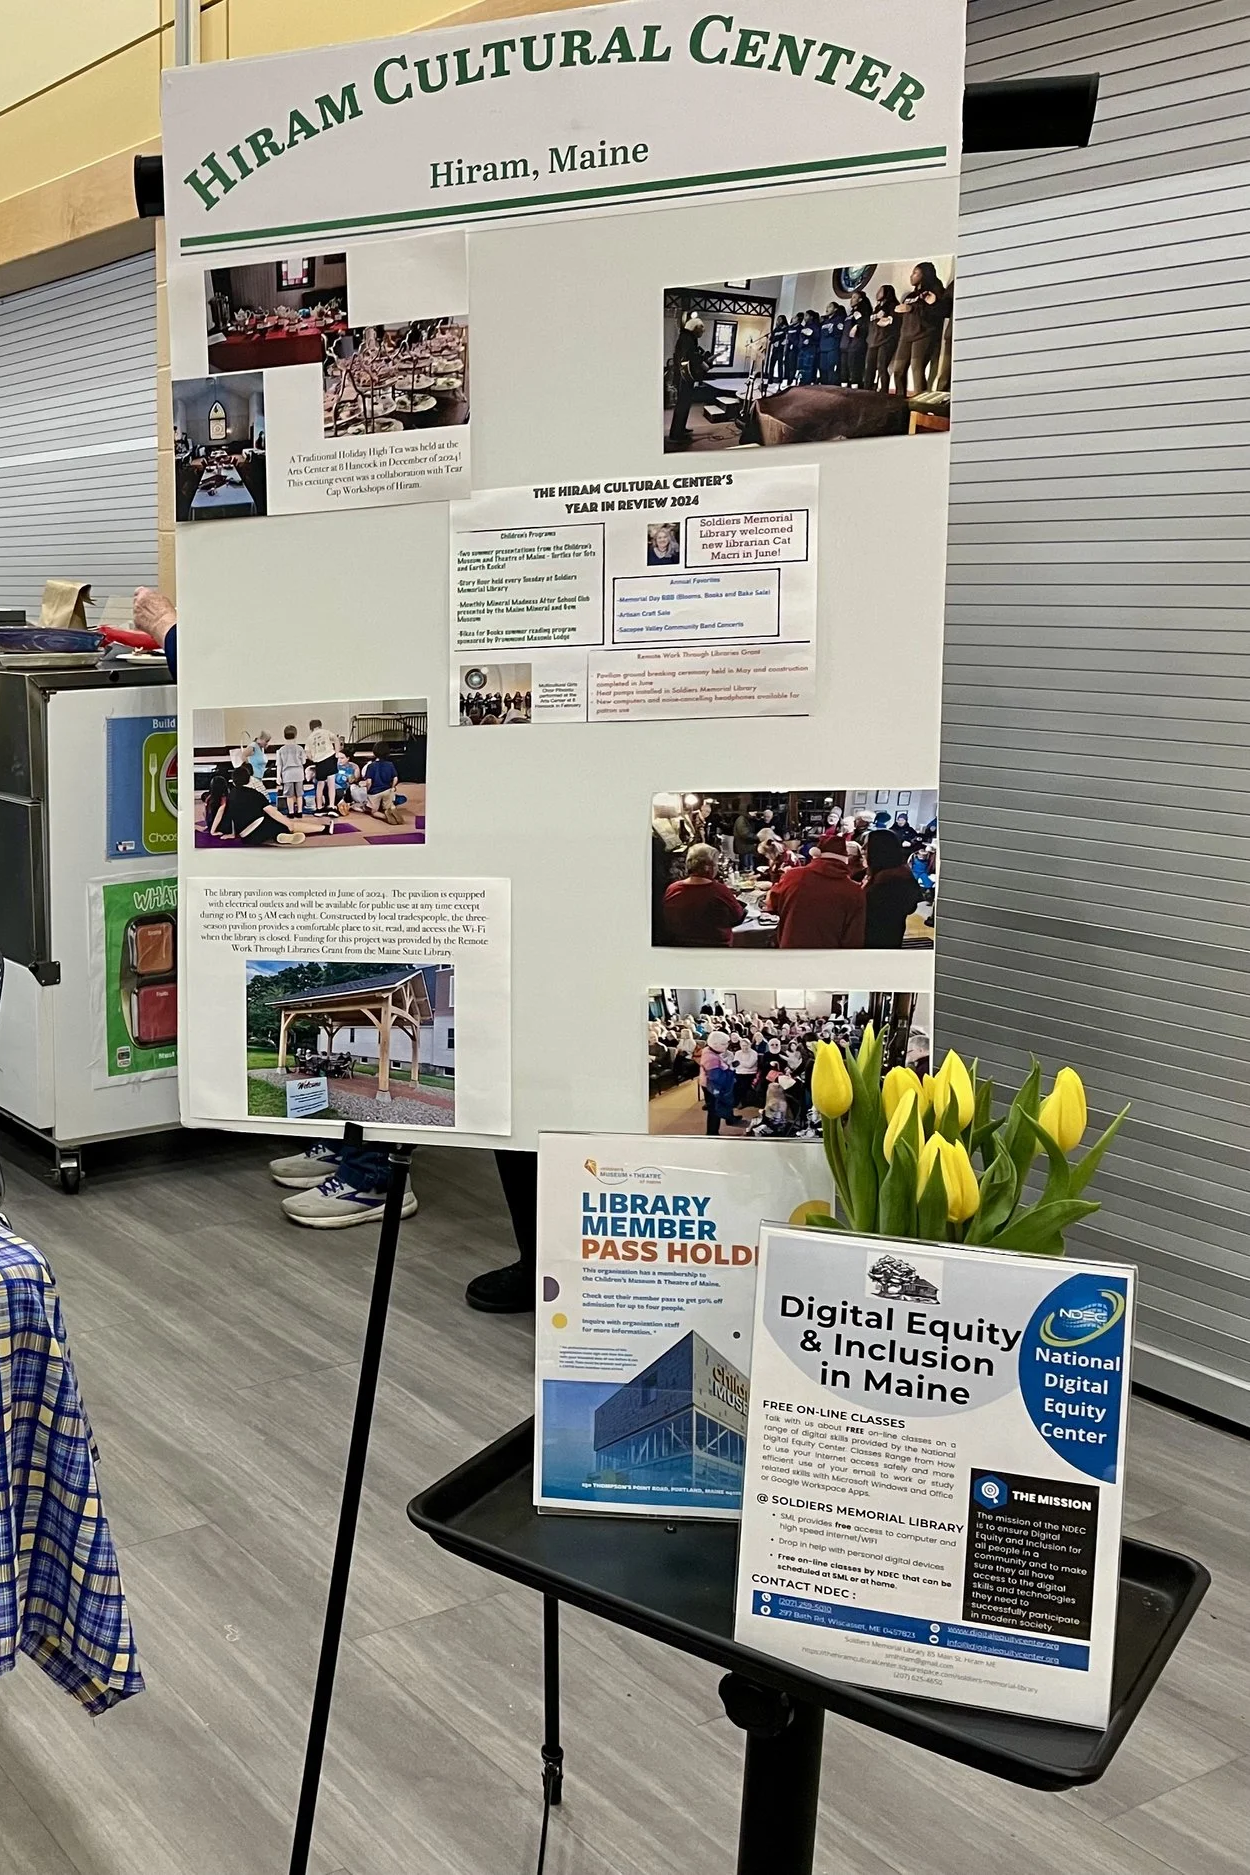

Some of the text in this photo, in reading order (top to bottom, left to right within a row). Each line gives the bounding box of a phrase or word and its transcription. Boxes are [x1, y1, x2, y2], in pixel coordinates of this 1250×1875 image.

[183, 15, 927, 212] HIRAM CULTURAL CENTER
[430, 139, 648, 191] Hiram, Maine
[297, 452, 337, 462] Traditional
[339, 449, 367, 459] Holiday
[369, 448, 387, 457] High
[389, 446, 403, 454] Tea
[420, 442, 436, 451] held
[326, 488, 341, 497] Cap
[343, 484, 385, 495] Workshops
[396, 481, 421, 490] Hiram.
[533, 474, 733, 498] THE HIRAM CULTURAL CENTER'S
[565, 495, 699, 514] YEAR IN REVIEW 2024
[700, 514, 793, 527] Soldiers Memorial
[700, 525, 793, 539] Library welcomed
[702, 537, 791, 549] new librarian Cat
[711, 551, 740, 560] Macri
[755, 549, 781, 558] June!
[152, 719, 175, 729] Build
[134, 885, 177, 911] WHAT
[219, 889, 242, 898] library
[244, 889, 272, 898] pavilion
[289, 890, 326, 899] completed
[337, 890, 354, 898] June
[356, 889, 365, 897] of
[408, 890, 438, 899] pavilion
[448, 891, 485, 900] equipped
[232, 944, 252, 952] Work
[254, 945, 285, 954] Through
[287, 946, 320, 954] Libraries
[322, 946, 343, 954] Grant
[378, 947, 401, 955] Maine
[582, 1192, 710, 1216] LIBRARY
[582, 1216, 717, 1240] MEMBER
[582, 1239, 758, 1265] PASS HOLD
[780, 1296, 1022, 1352] Digital Equity
[800, 1330, 995, 1376] & Inclusion
[1036, 1347, 1120, 1371] National
[820, 1362, 970, 1405] in Maine
[1045, 1373, 1108, 1394] Digital
[763, 1400, 905, 1428] FREE ON-LINE CLASSES
[1045, 1398, 1106, 1422] Equity
[1041, 1423, 1107, 1444] Center
[1012, 1491, 1091, 1511] THE MISSION
[757, 1493, 964, 1533] @ SOLDIERS MEMORIAL LIBRARY
[977, 1511, 1086, 1535] The mission of the NDEC
[976, 1532, 1082, 1554] Equity and Inclusion for
[997, 1527, 1029, 1536] ensure
[1031, 1530, 1060, 1541] Digital
[778, 1553, 795, 1562] Free
[798, 1557, 827, 1567] on-line
[831, 1562, 861, 1573] classes
[864, 1567, 874, 1577] by
[877, 1570, 900, 1579] NDEC
[902, 1574, 919, 1583] that
[941, 1579, 951, 1588] be
[974, 1553, 1087, 1576] community and to make
[974, 1562, 1054, 1581] sure they all have
[752, 1574, 850, 1599] CONTACT NDEC
[973, 1573, 1006, 1582] access
[1019, 1578, 1034, 1588] the
[1037, 1581, 1066, 1592] digital
[973, 1581, 1076, 1604] skills and technologies
[972, 1591, 992, 1602] they
[995, 1595, 1018, 1604] need
[971, 1601, 1080, 1625] successfully participate
[981, 1613, 1018, 1625] modern
[1019, 1619, 1054, 1631] society.
